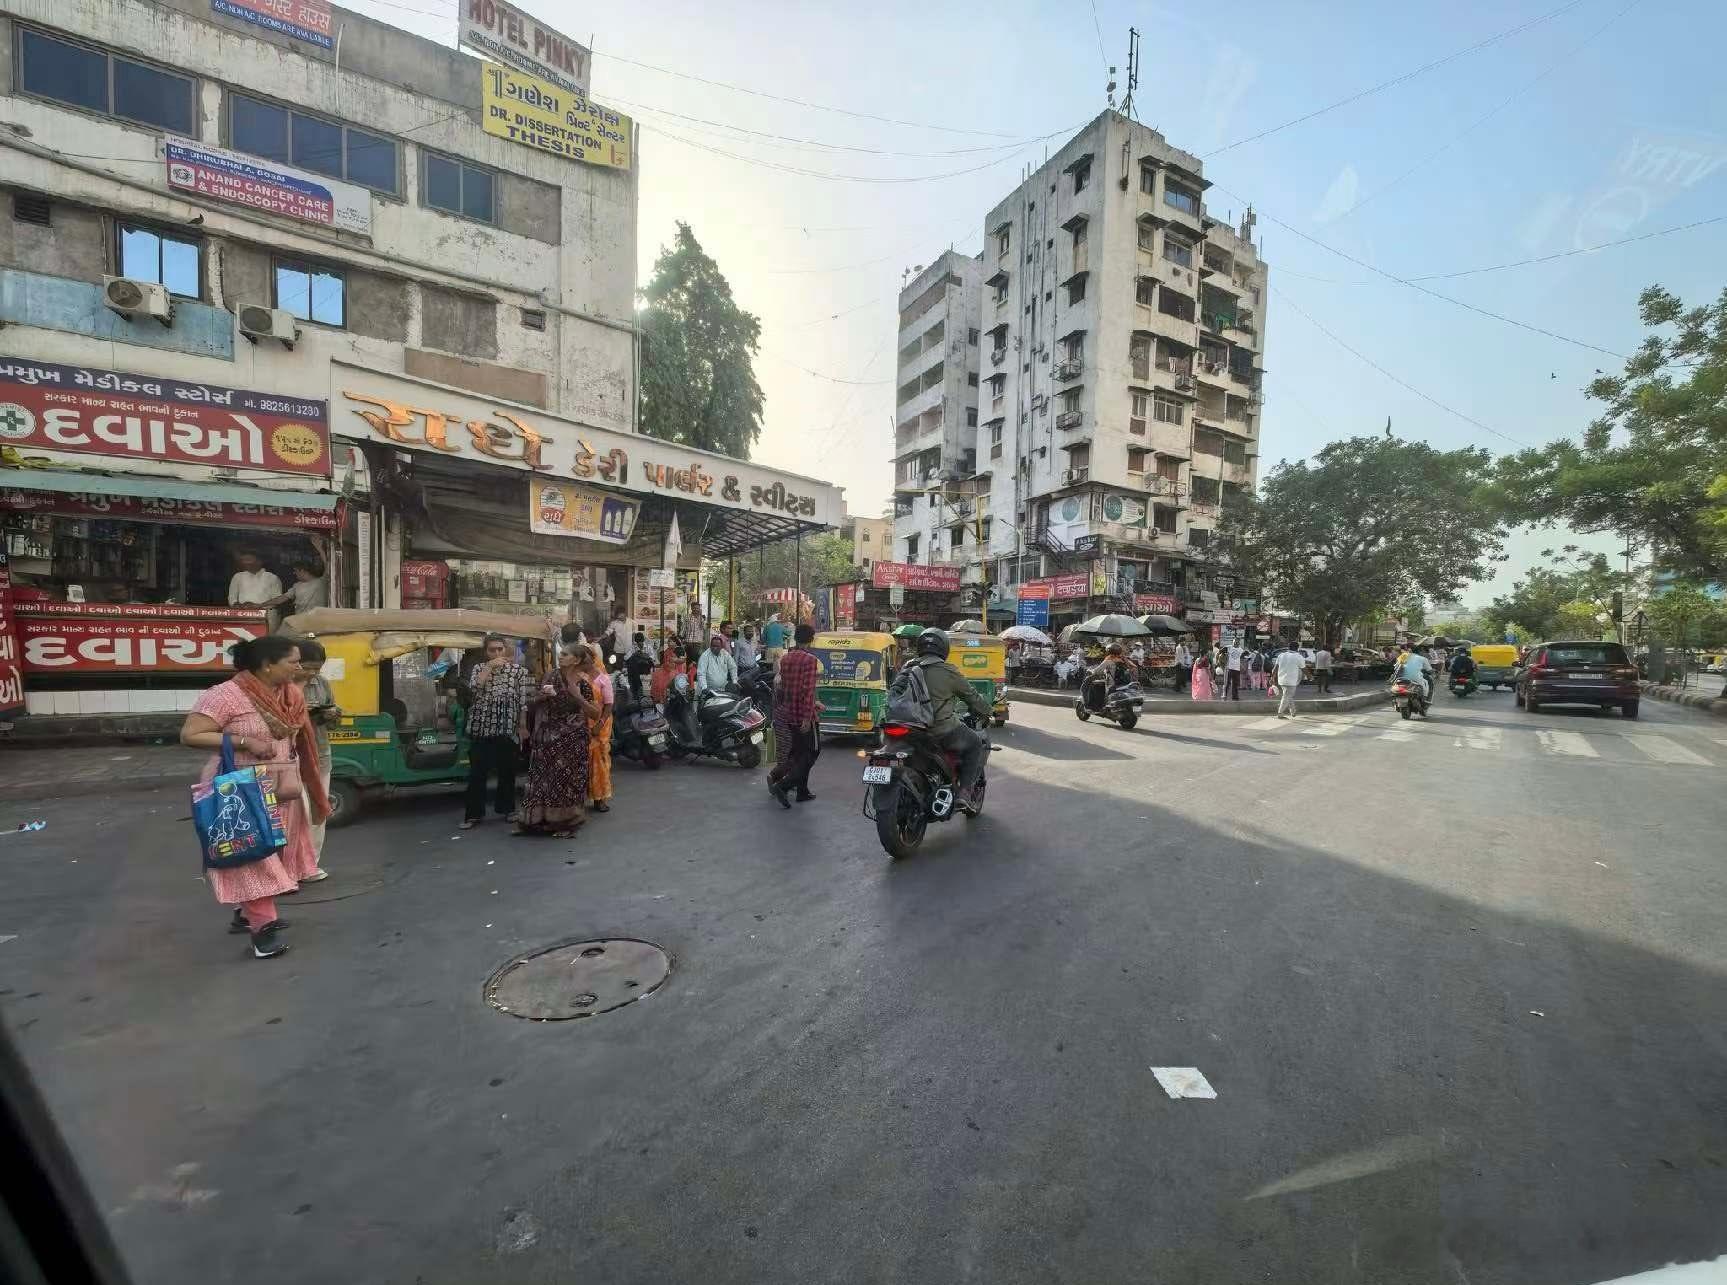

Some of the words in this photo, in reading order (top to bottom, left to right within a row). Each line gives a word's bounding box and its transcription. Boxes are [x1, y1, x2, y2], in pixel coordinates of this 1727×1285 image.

[470, 0, 528, 49] HOTEL
[534, 27, 585, 79] PINKY
[490, 104, 511, 122] DR.
[515, 113, 602, 150] DISSERTATION
[506, 125, 585, 159] THESIS
[198, 170, 241, 188] ANAND
[245, 182, 294, 203] CANCER
[298, 196, 329, 212] CARE
[198, 182, 208, 192] &
[211, 186, 286, 212] ENDOSCOPY
[290, 206, 329, 223] CLINIC
[74, 370, 162, 396] મેડીકલ
[174, 385, 235, 405] સ્ટોર્સ
[43, 408, 264, 465] દવાઓ
[572, 439, 628, 485] ડેરી
[642, 463, 713, 497] પાર્લર
[721, 474, 741, 503] &
